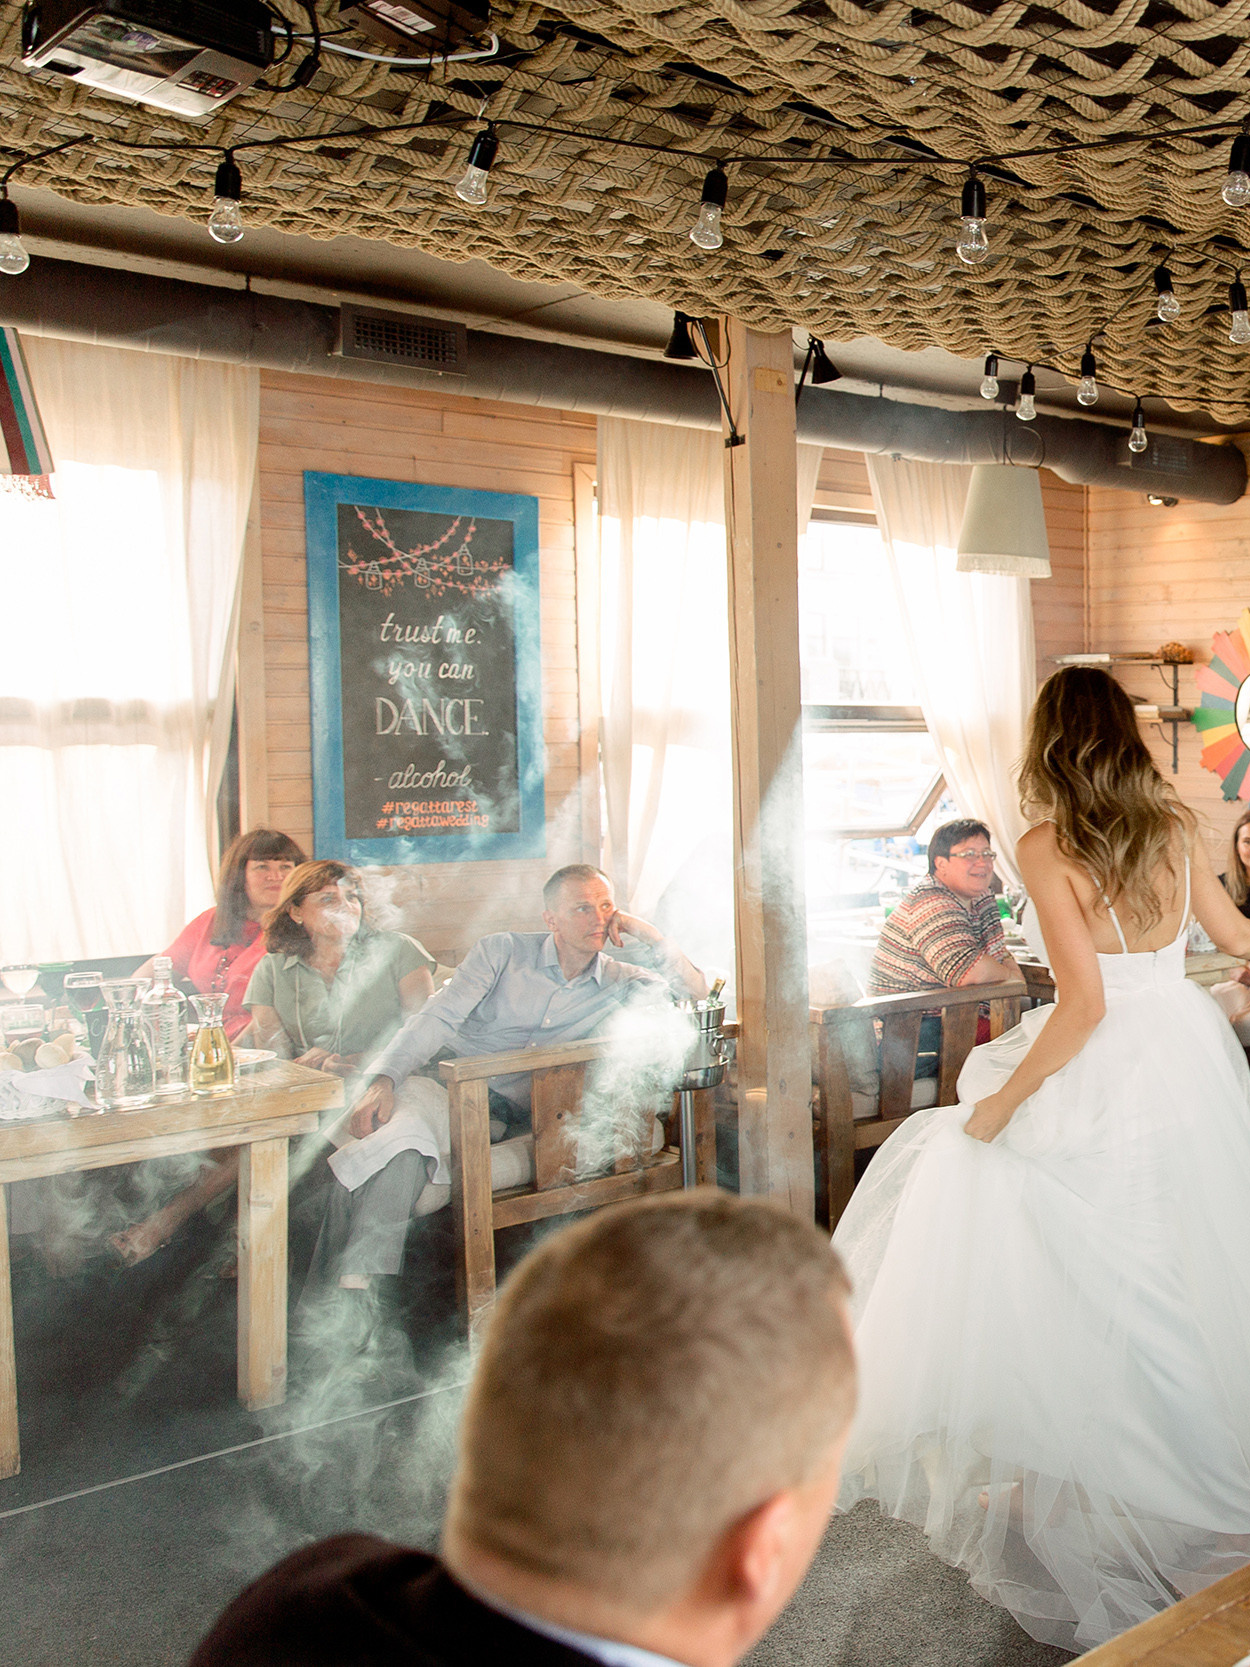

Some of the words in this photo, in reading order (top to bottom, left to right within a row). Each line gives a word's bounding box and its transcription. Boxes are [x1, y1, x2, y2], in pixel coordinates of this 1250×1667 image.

[380, 612, 445, 644] trust
[445, 627, 482, 644] me.
[388, 661, 432, 685] you
[438, 662, 475, 680] can
[375, 696, 490, 736] DANCE.
[381, 799, 480, 817] #regattarest
[376, 814, 490, 832] #regattawedding
